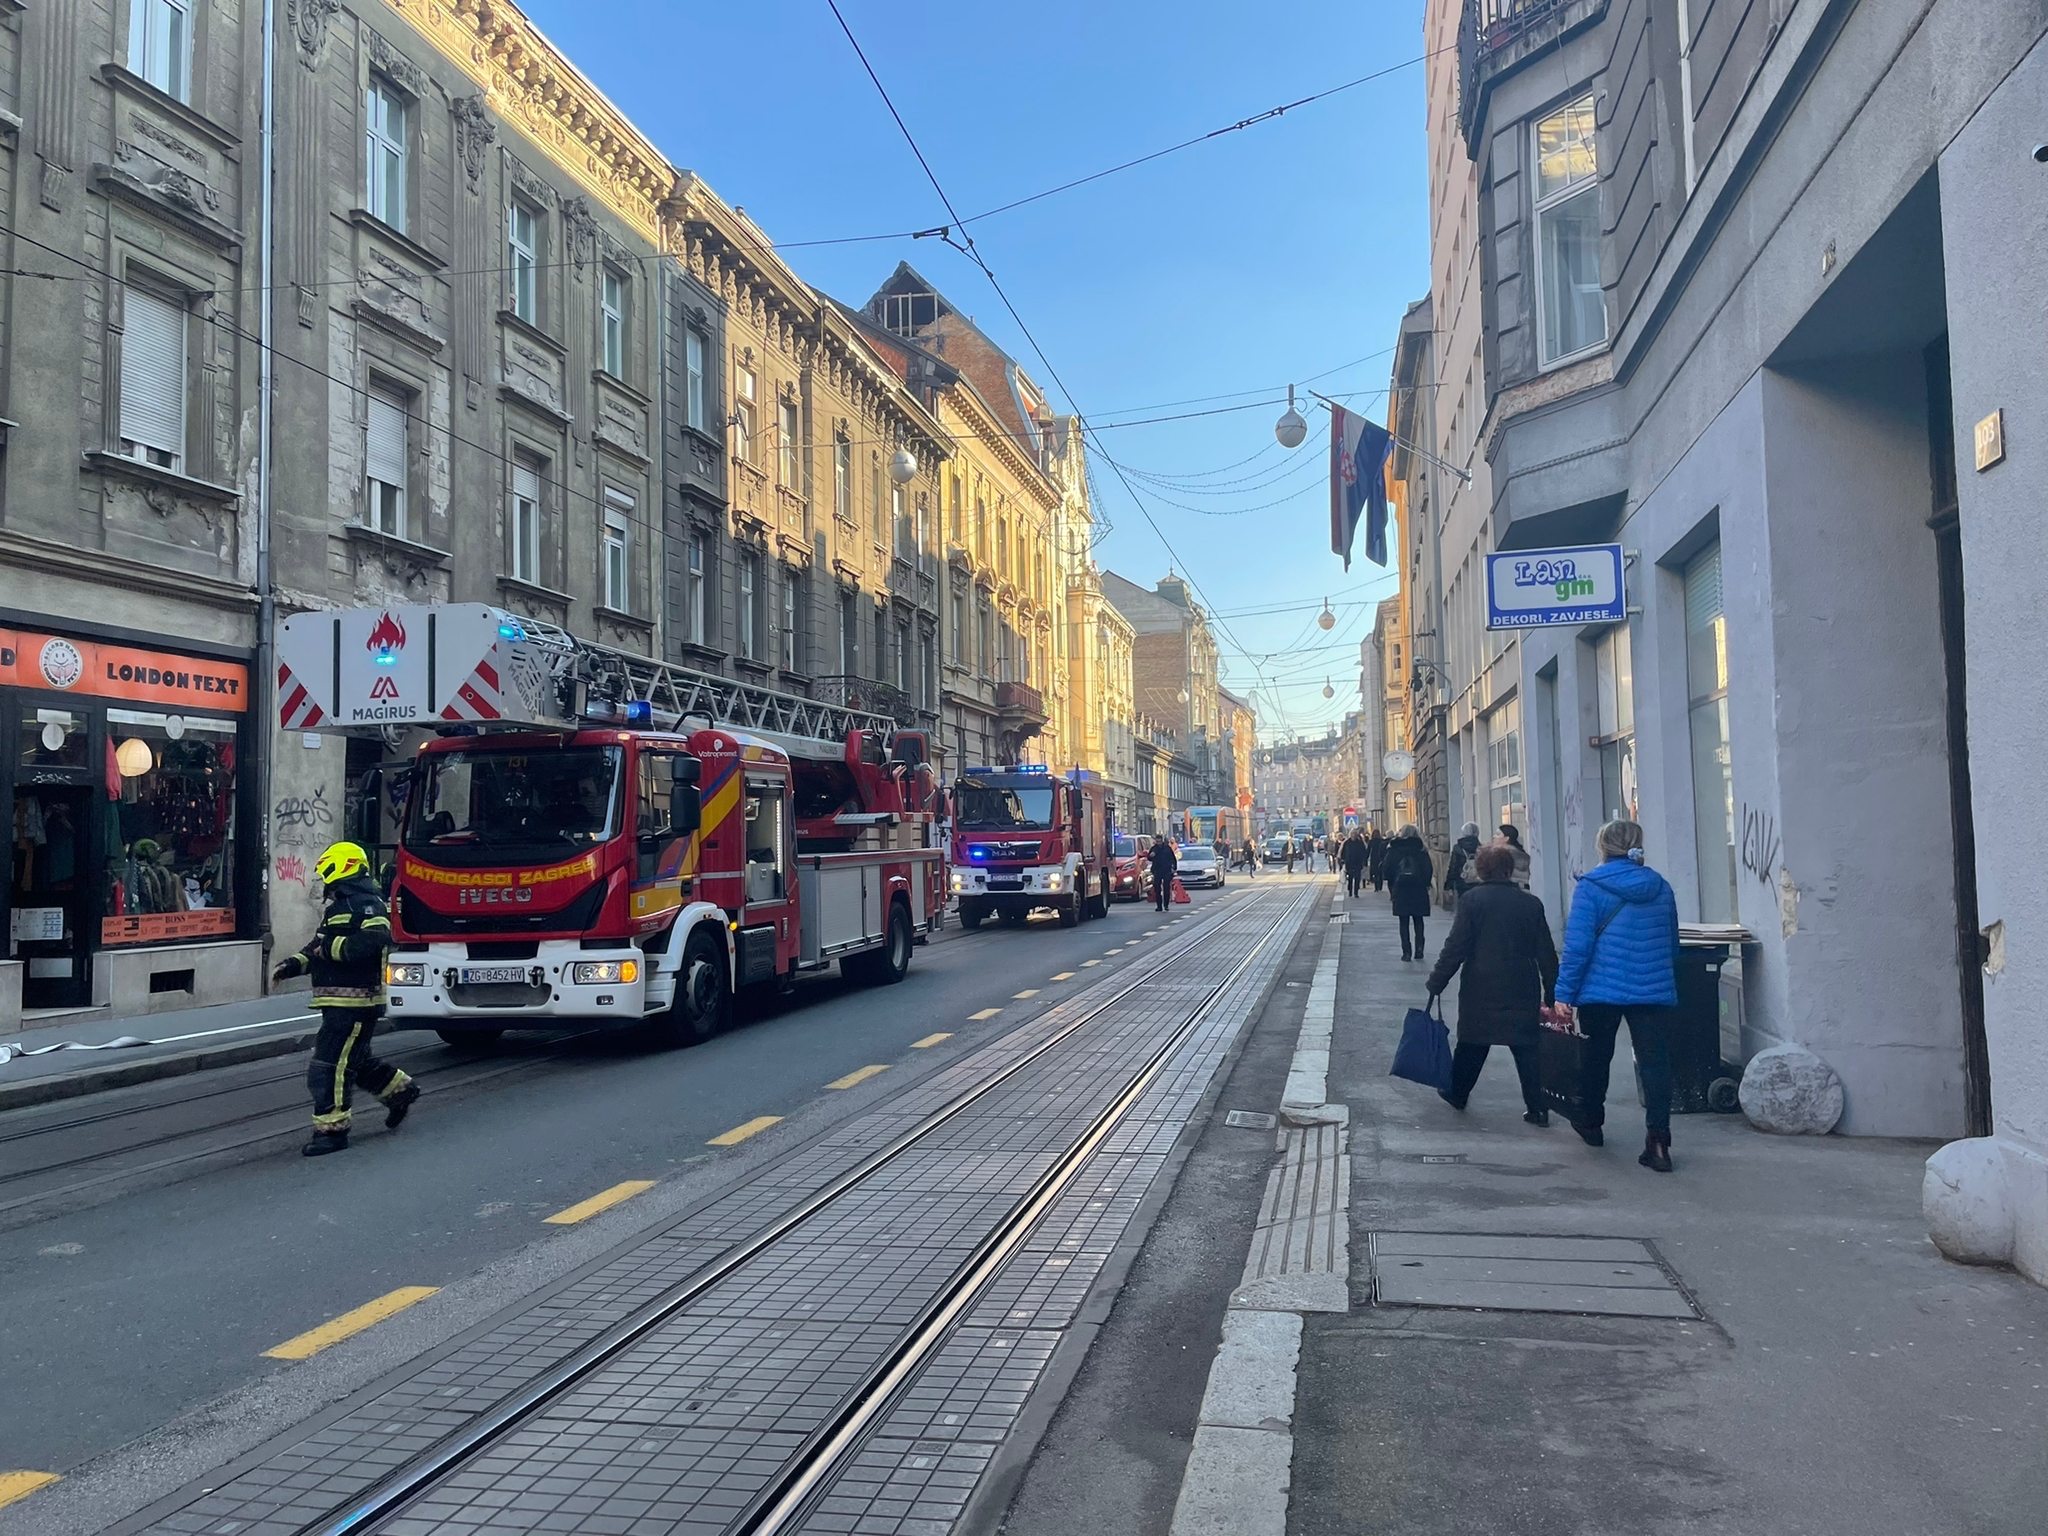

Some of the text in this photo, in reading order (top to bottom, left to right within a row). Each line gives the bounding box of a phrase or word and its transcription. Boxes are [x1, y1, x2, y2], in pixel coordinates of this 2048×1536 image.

[1977, 421, 1995, 449] 103
[1514, 559, 1578, 587] Lan
[1555, 579, 1594, 602] gm
[1493, 609, 1622, 626] DEKORI, ZAVJESE...
[107, 662, 239, 695] LONDON TEXT
[508, 662, 538, 720] MAGIRUS
[352, 705, 417, 721] MAGIRUS
[405, 857, 598, 887] VATROGASCI ZAGREB
[459, 886, 533, 905] IVECO
[165, 914, 186, 924] BOSS
[469, 970, 481, 982] ZG
[486, 969, 509, 982] 8452
